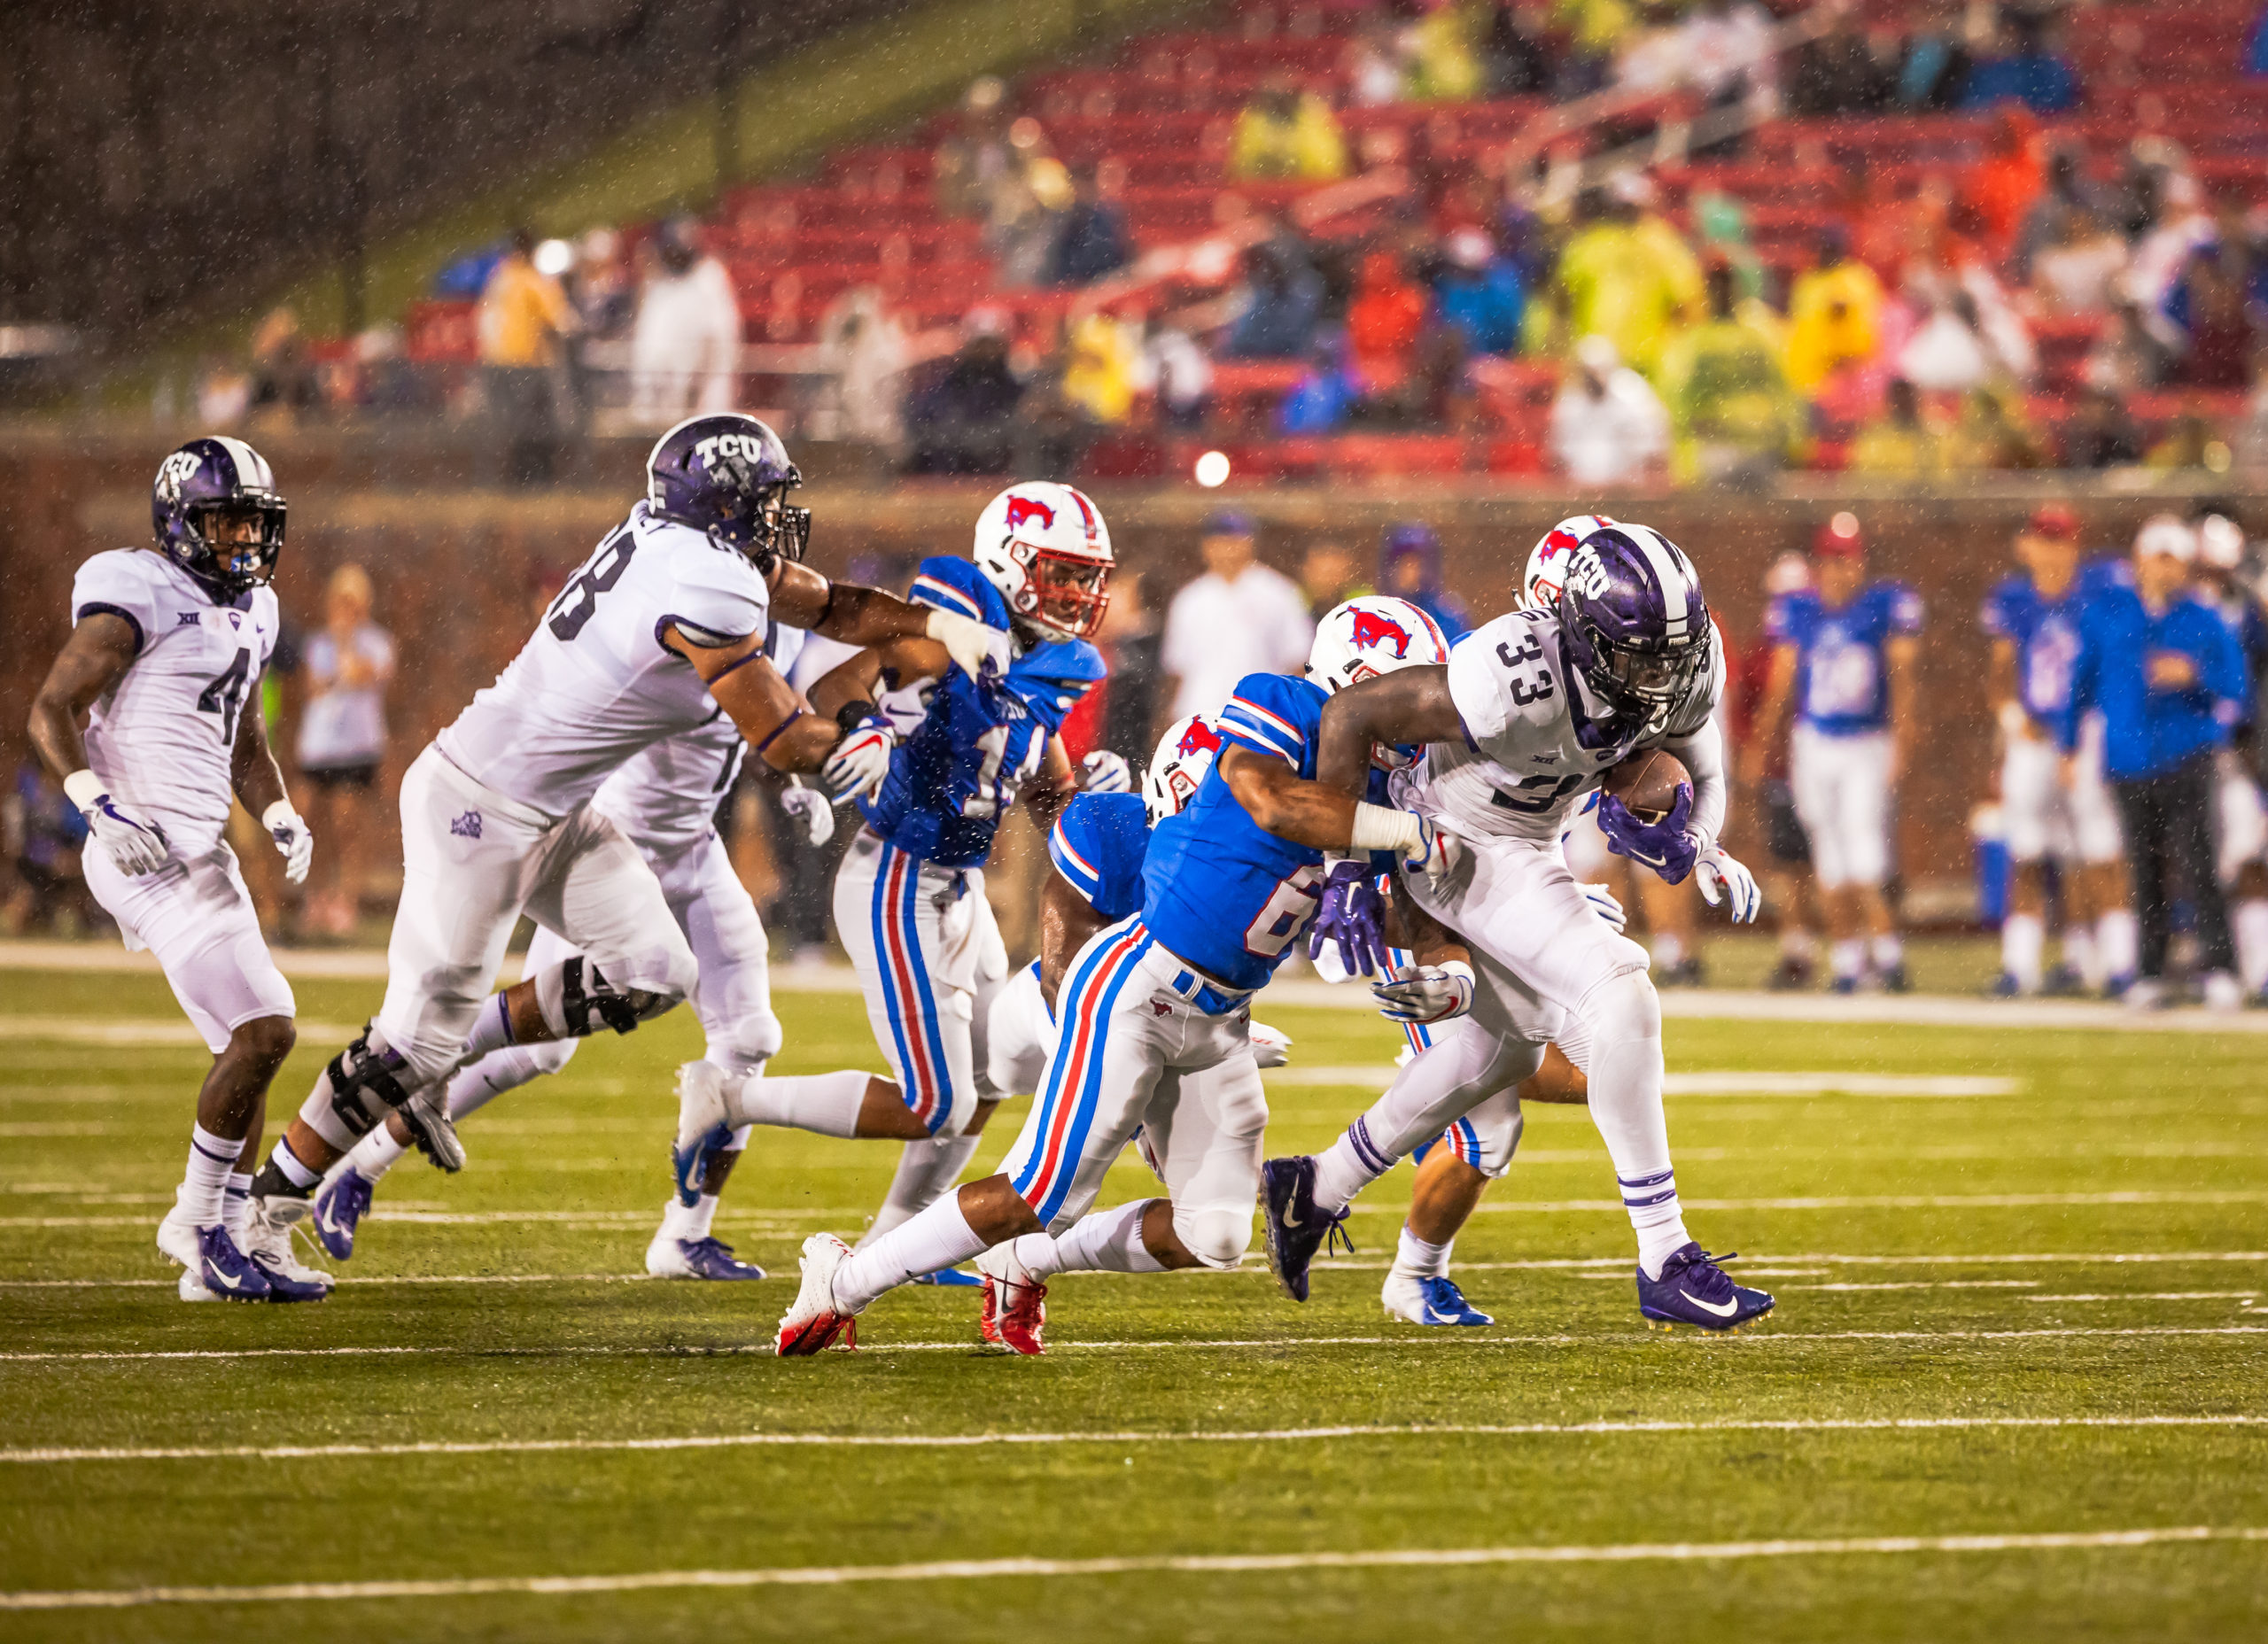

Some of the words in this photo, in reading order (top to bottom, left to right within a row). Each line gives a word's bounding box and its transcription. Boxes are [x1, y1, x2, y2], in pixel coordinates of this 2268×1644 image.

[696, 434, 762, 469] TCU
[1568, 542, 1612, 601] TCU
[177, 612, 200, 625] XII
[197, 647, 251, 746] 4
[1496, 633, 1555, 707] 33
[1243, 864, 1324, 958] 6
